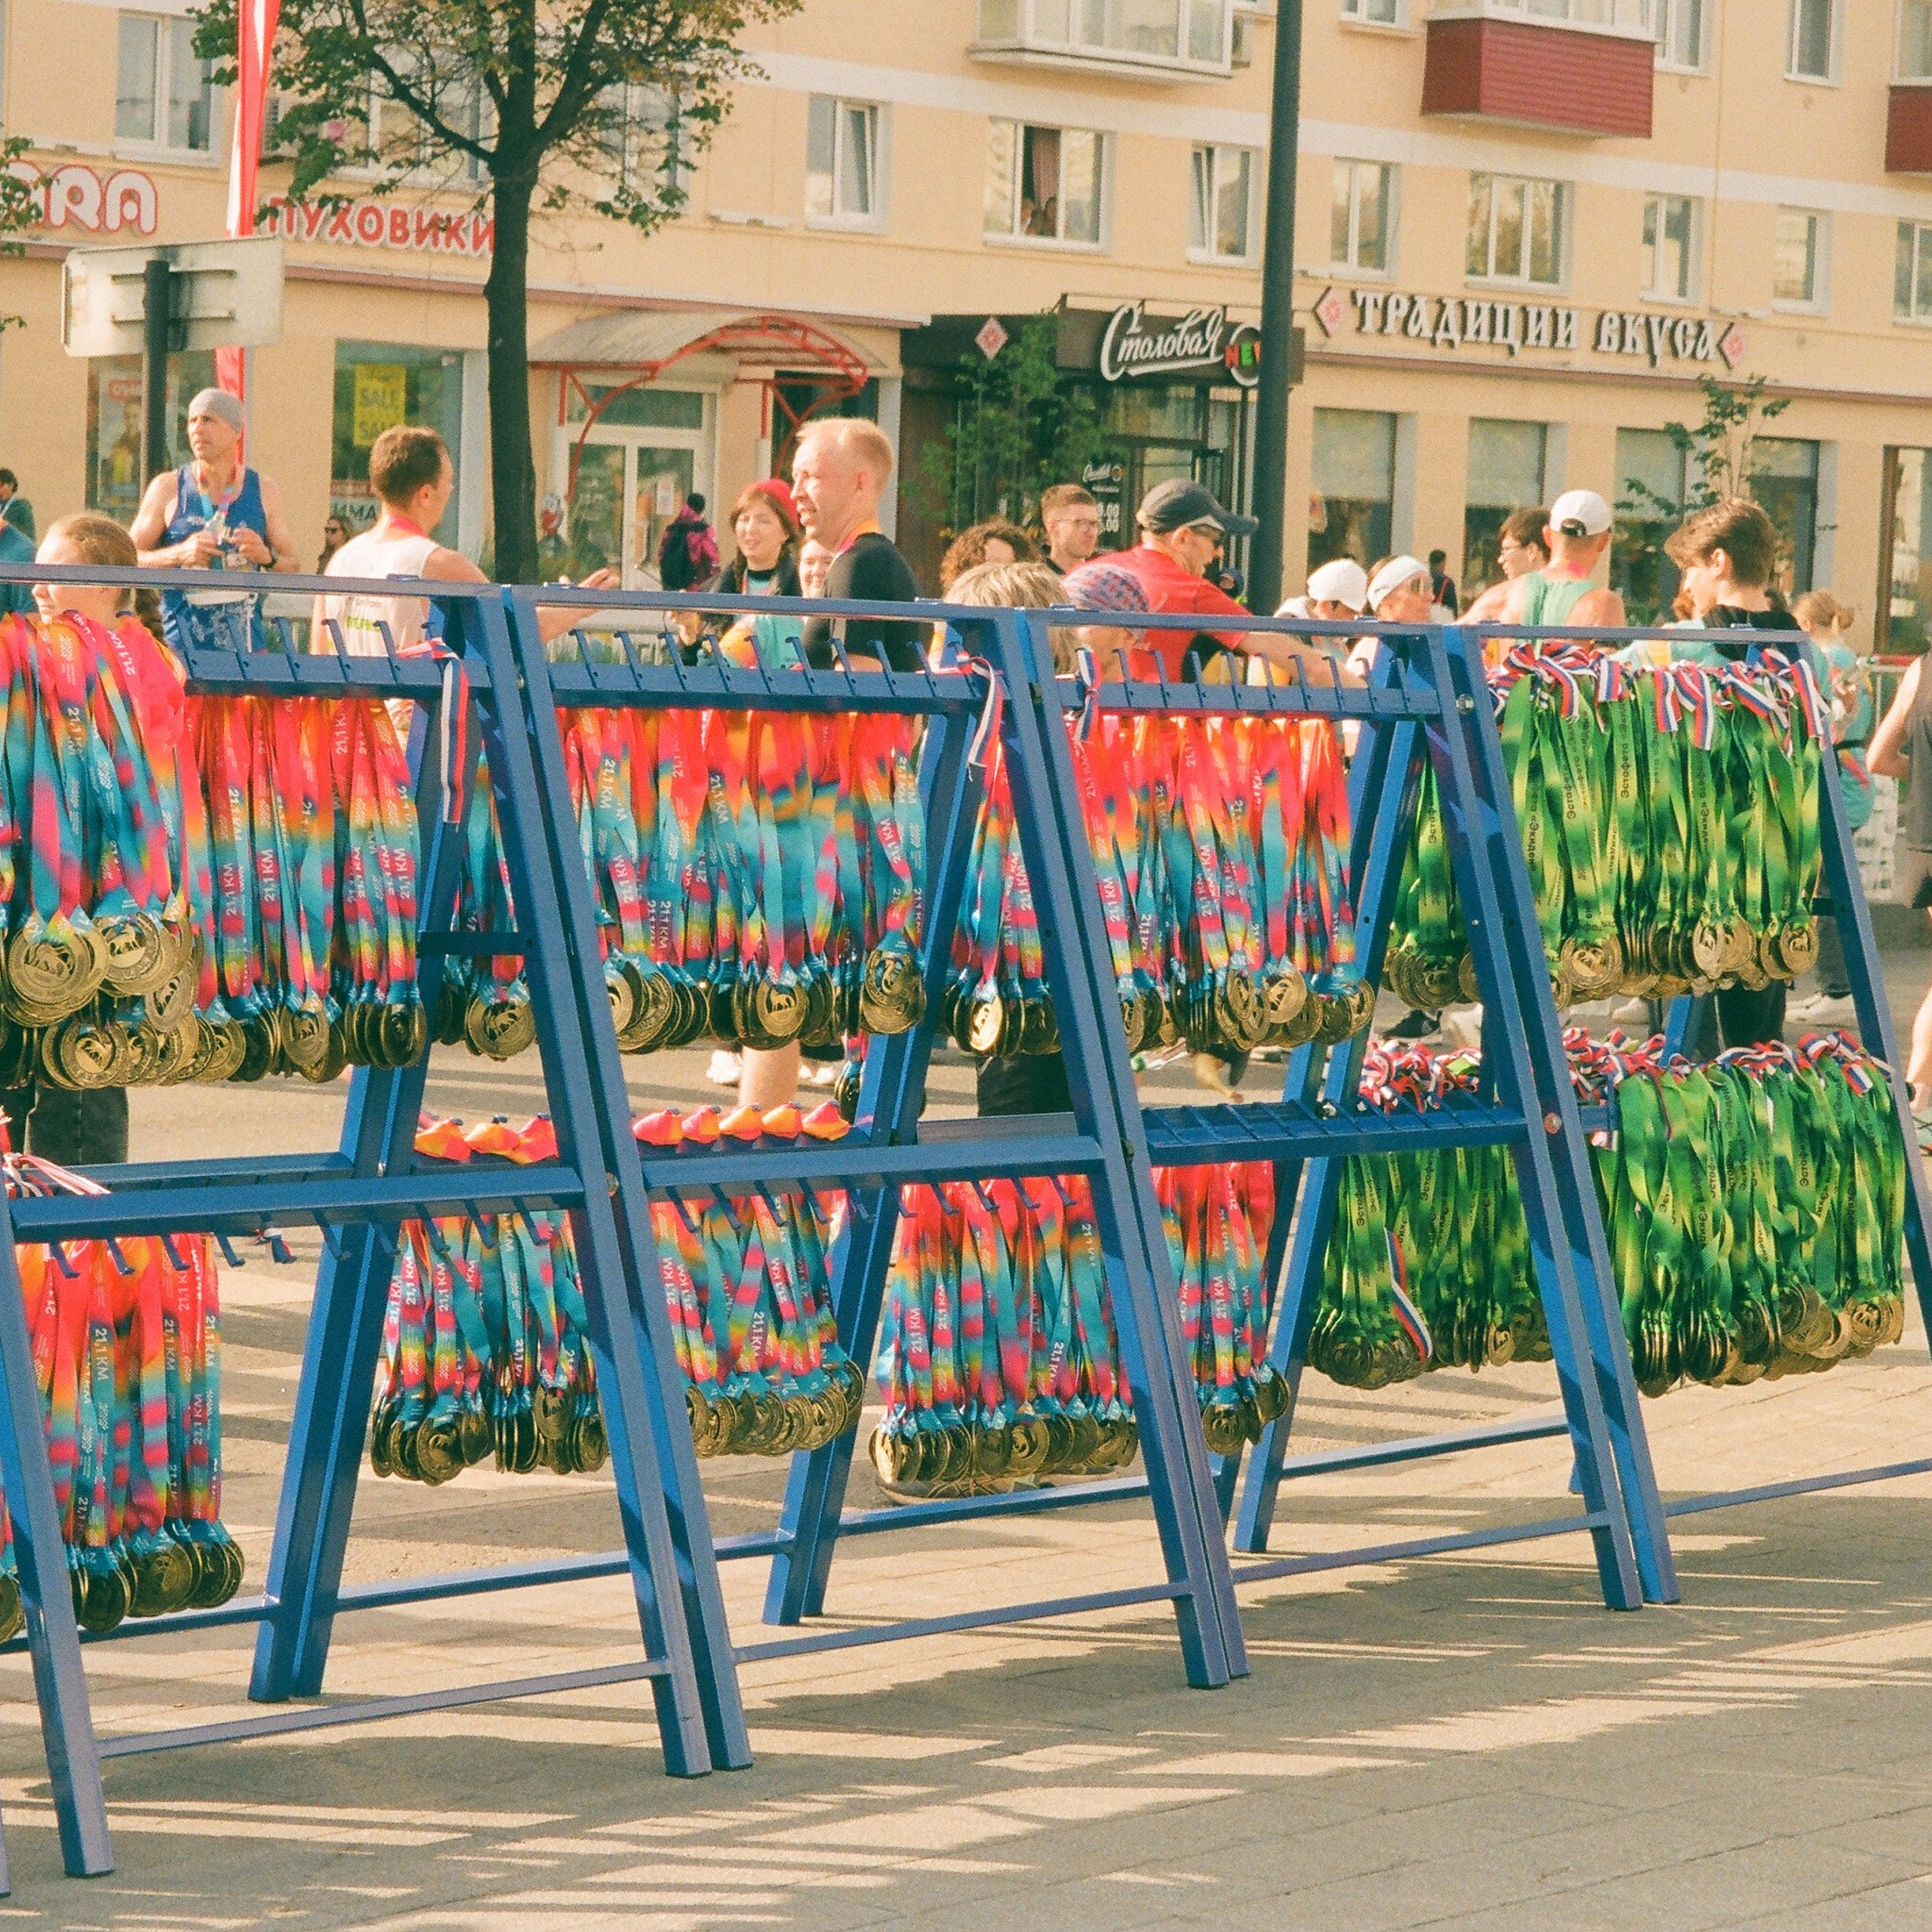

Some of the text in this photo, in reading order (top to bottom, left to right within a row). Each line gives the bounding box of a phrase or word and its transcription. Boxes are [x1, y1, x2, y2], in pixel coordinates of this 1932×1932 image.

[267, 195, 494, 254] ПУХОВИКИ
[1100, 303, 1225, 381] Столовая
[1352, 290, 1718, 368] ТРАДИЦИИ ВКУСА
[600, 759, 616, 809] 21,1 KM
[223, 863, 234, 887] KM
[261, 848, 275, 902] 21,1 KM
[393, 848, 408, 872] KM
[405, 1257, 414, 1279] KM
[436, 1263, 448, 1285] KM
[1214, 1275, 1225, 1297] KM
[909, 1308, 921, 1328] KM
[95, 1328, 109, 1381] 21,1 KM
